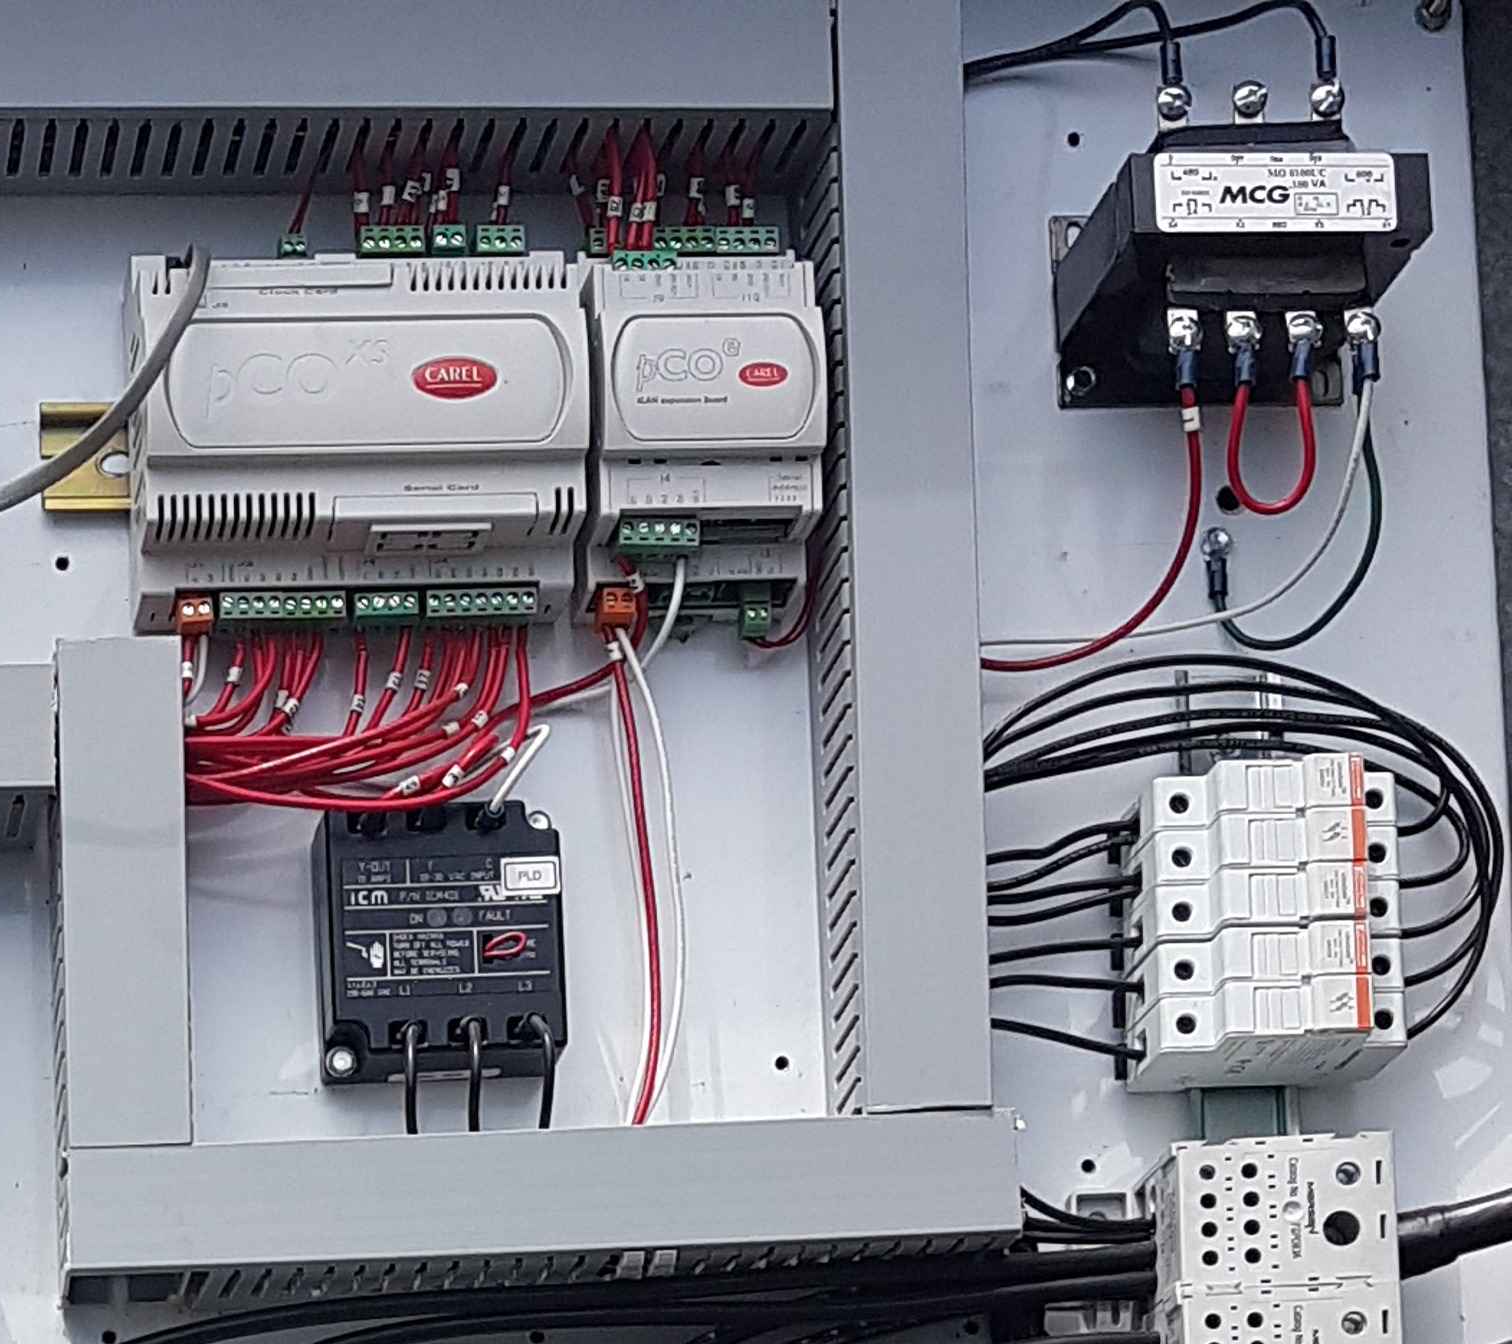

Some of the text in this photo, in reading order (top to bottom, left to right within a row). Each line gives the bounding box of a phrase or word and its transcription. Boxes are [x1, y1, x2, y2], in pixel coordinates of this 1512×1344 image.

[1219, 186, 1290, 203] MCG
[424, 366, 482, 383] CAREL
[518, 870, 542, 882] PLD
[479, 910, 511, 921] FAULT
[399, 986, 411, 996] L1
[458, 983, 473, 993] L2
[518, 981, 532, 991] L3
